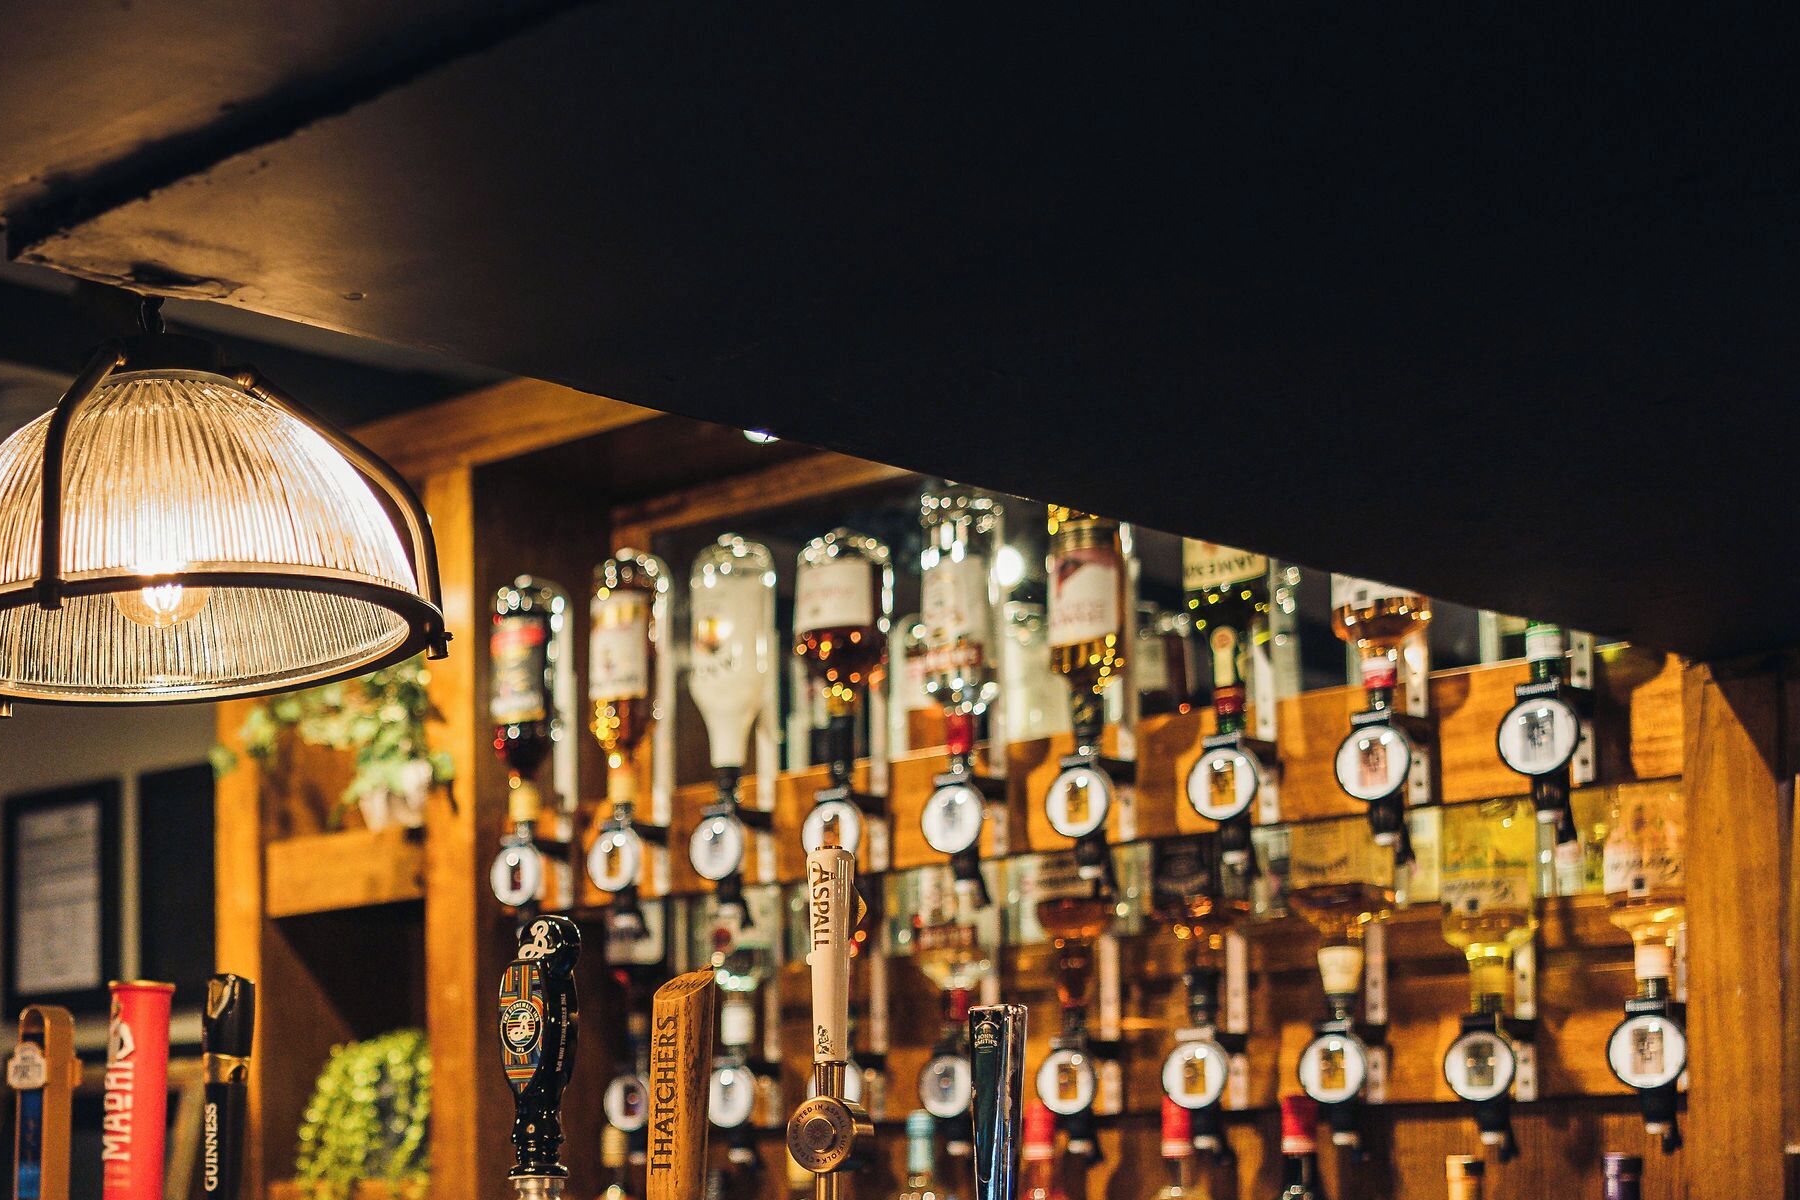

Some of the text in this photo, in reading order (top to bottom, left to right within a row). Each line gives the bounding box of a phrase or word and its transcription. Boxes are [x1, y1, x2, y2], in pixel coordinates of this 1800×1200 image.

[812, 861, 836, 950] ASPALL
[651, 1014, 678, 1176] THATCHERS
[204, 1102, 218, 1192] GUINNESS
